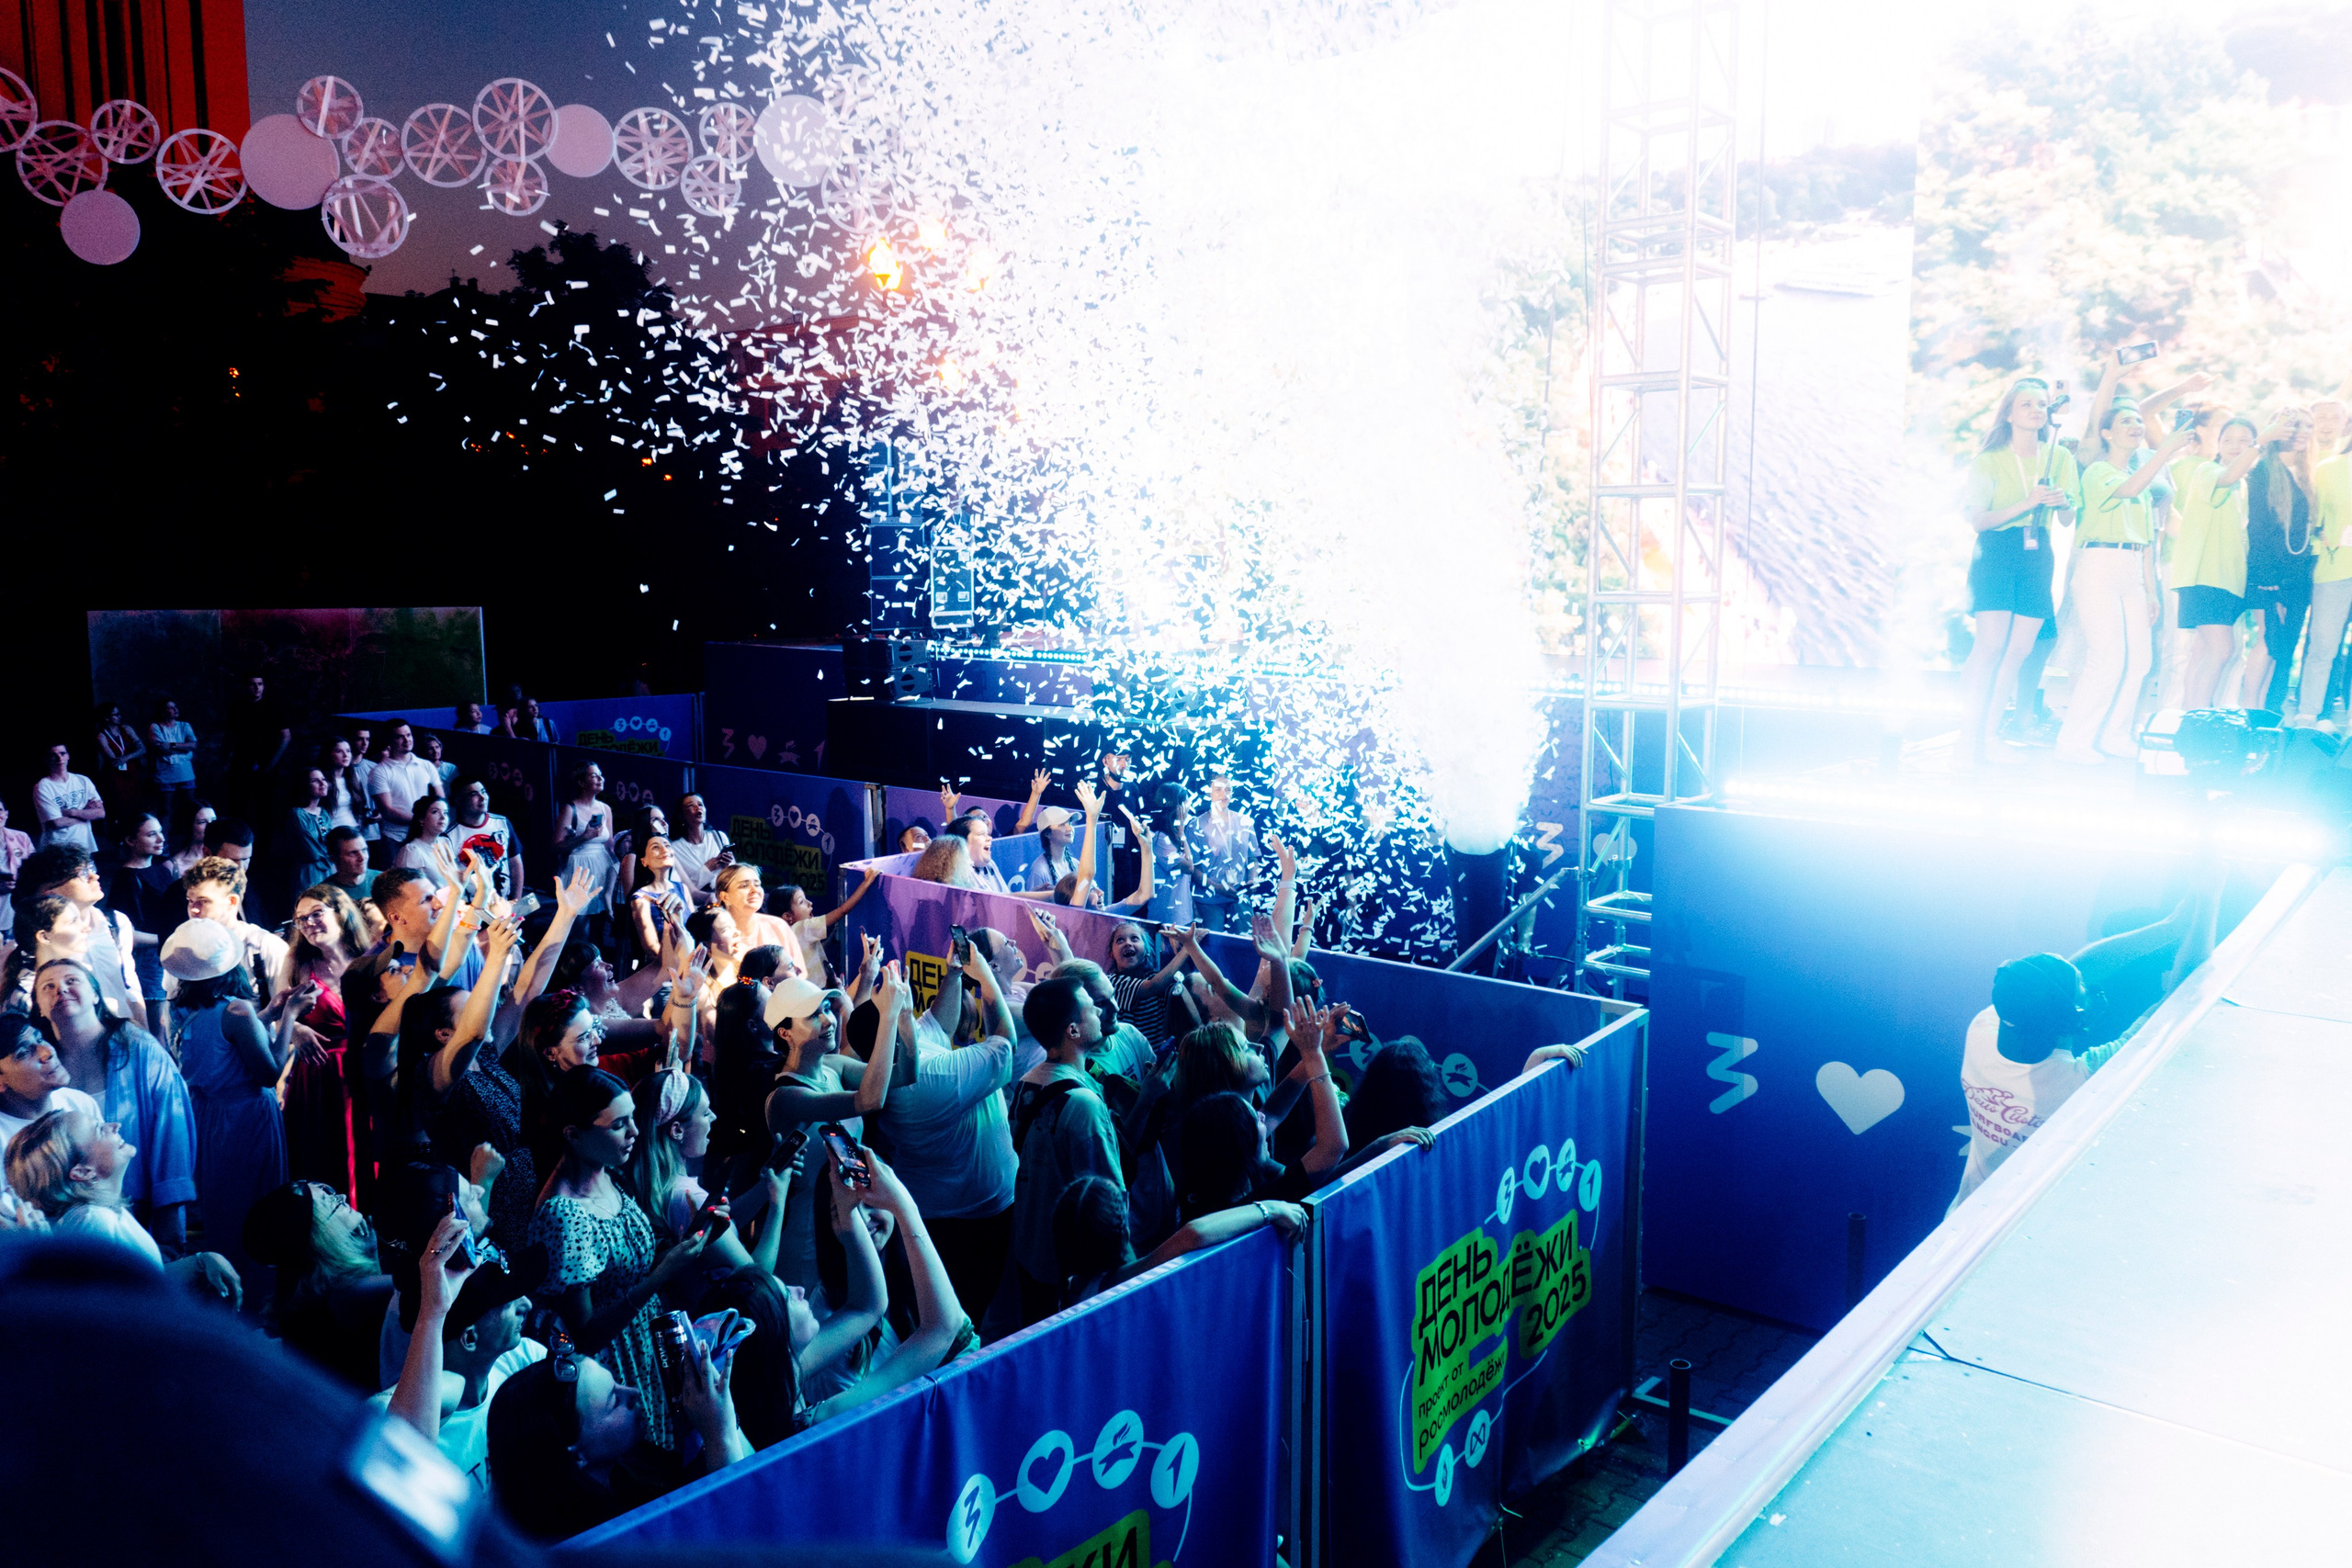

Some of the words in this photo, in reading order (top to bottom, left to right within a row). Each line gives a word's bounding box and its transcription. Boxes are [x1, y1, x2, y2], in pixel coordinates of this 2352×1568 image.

[578, 732, 614, 746] ДЕНЬ
[731, 818, 771, 840] ДЕНЬ
[791, 872, 825, 891] 2025
[1419, 1240, 1492, 1340] ДЕНЬ
[1419, 1221, 1572, 1387] МОЛОДЁЖИ
[1527, 1260, 1587, 1348] 2025
[655, 1330, 669, 1369] POWER
[1419, 1375, 1449, 1418] проект
[1452, 1362, 1464, 1381] от
